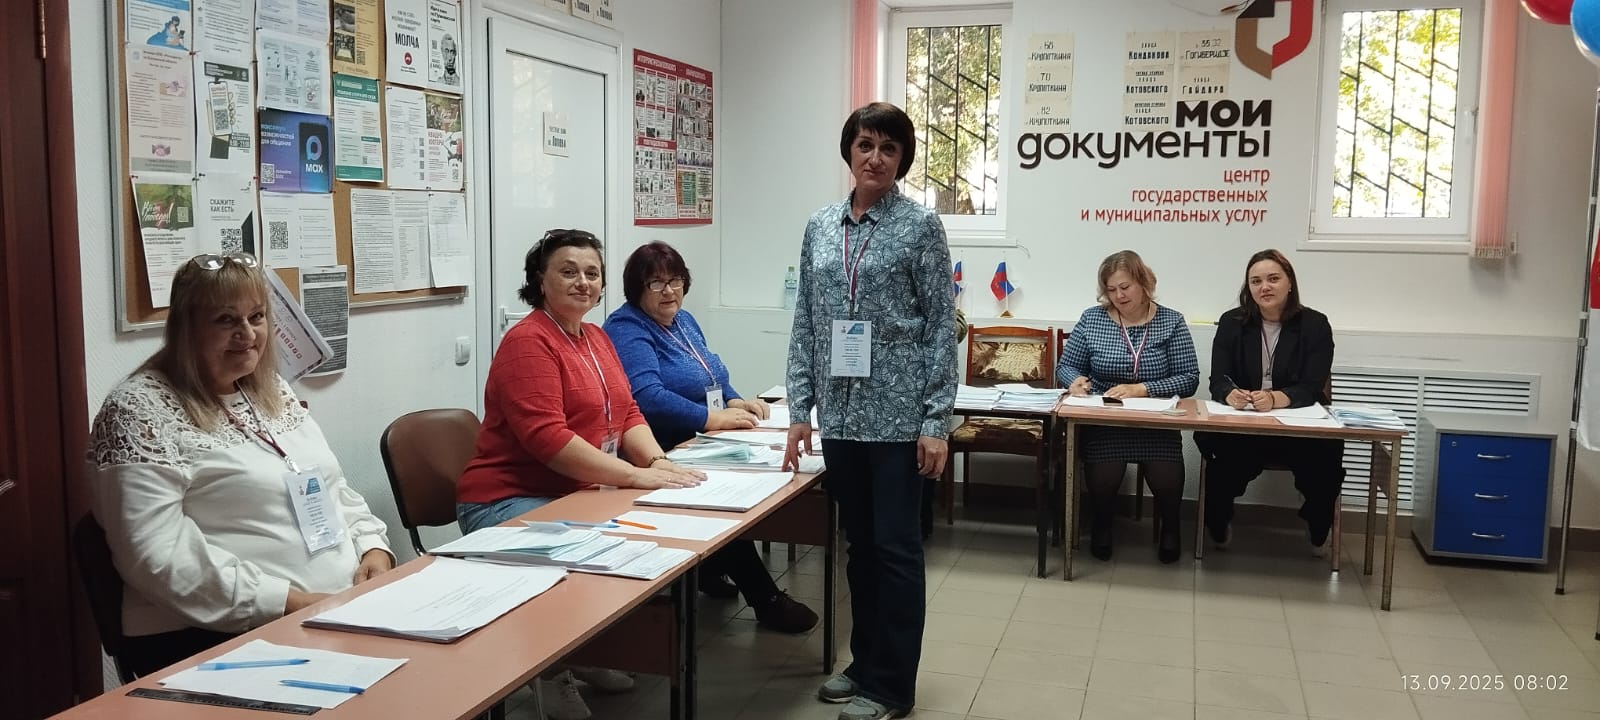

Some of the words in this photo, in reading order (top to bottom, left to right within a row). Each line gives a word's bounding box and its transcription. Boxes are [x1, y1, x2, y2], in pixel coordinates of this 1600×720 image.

[395, 31, 420, 49] МОЛЧА
[1040, 72, 1051, 81] 70
[1126, 84, 1169, 94] Котовского
[1125, 115, 1170, 125] Котовского
[1017, 129, 1271, 169] документы
[1223, 169, 1271, 185] центр
[1131, 189, 1268, 206] государственных
[1080, 209, 1090, 221] и
[1094, 209, 1220, 225] муниципальных
[1225, 209, 1268, 226] услуг
